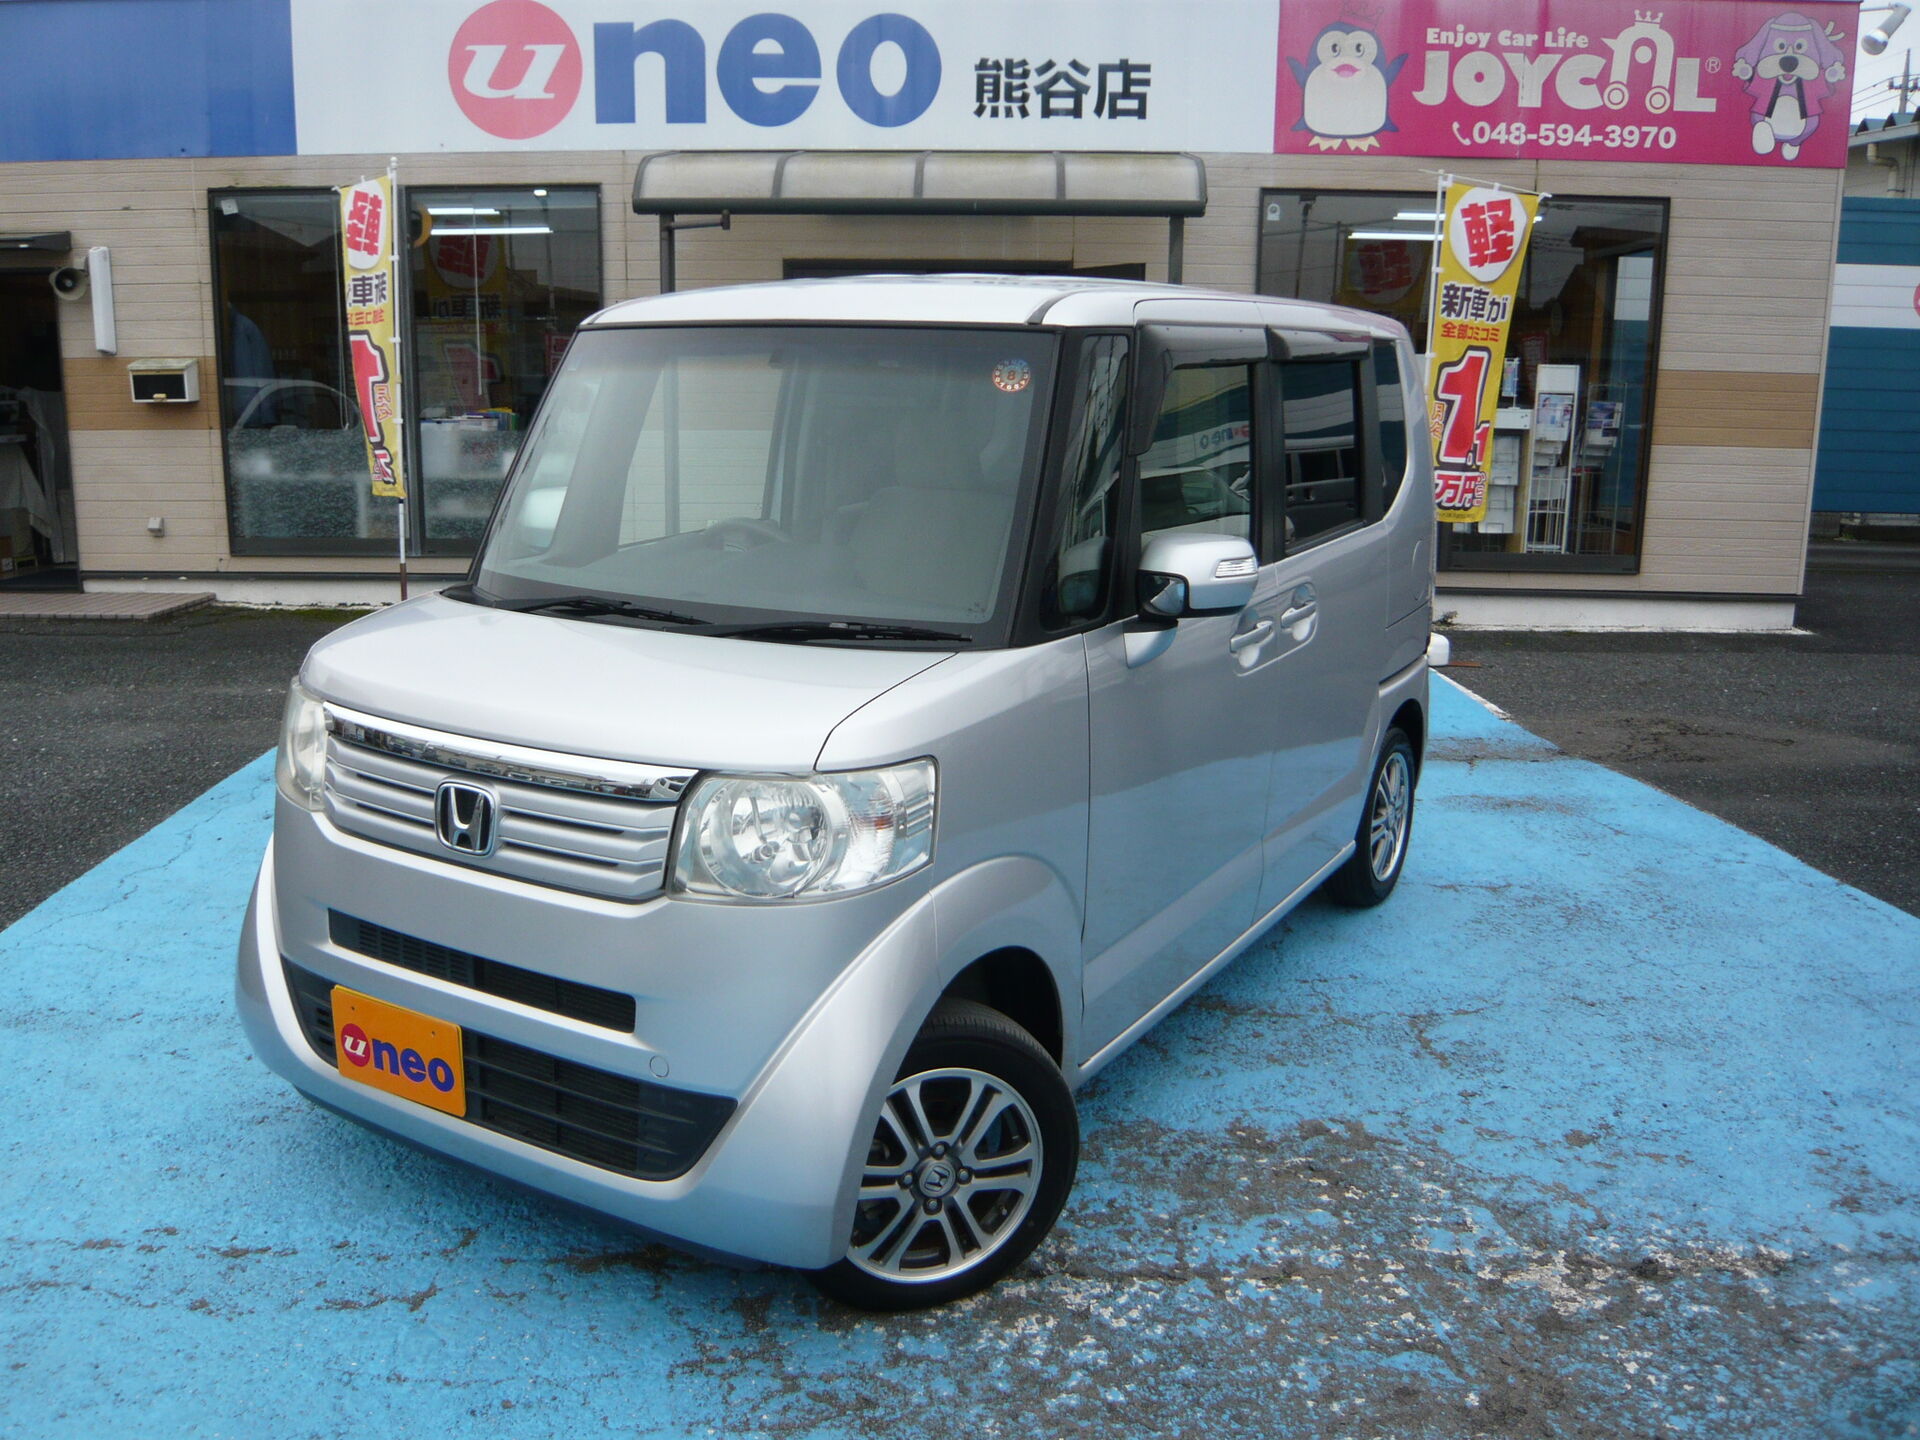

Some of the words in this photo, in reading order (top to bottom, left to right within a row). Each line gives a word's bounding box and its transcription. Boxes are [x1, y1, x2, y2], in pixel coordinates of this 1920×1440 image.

[1426, 24, 1491, 48] Enjoy
[1498, 29, 1538, 47] Car
[1544, 27, 1589, 48] Life
[973, 58, 1151, 120] 熊谷店
[1472, 121, 1677, 149] 048-594-3970
[1460, 198, 1515, 268] 軽
[1440, 283, 1507, 322] 新車が
[1441, 321, 1500, 342] 全部コミコミ
